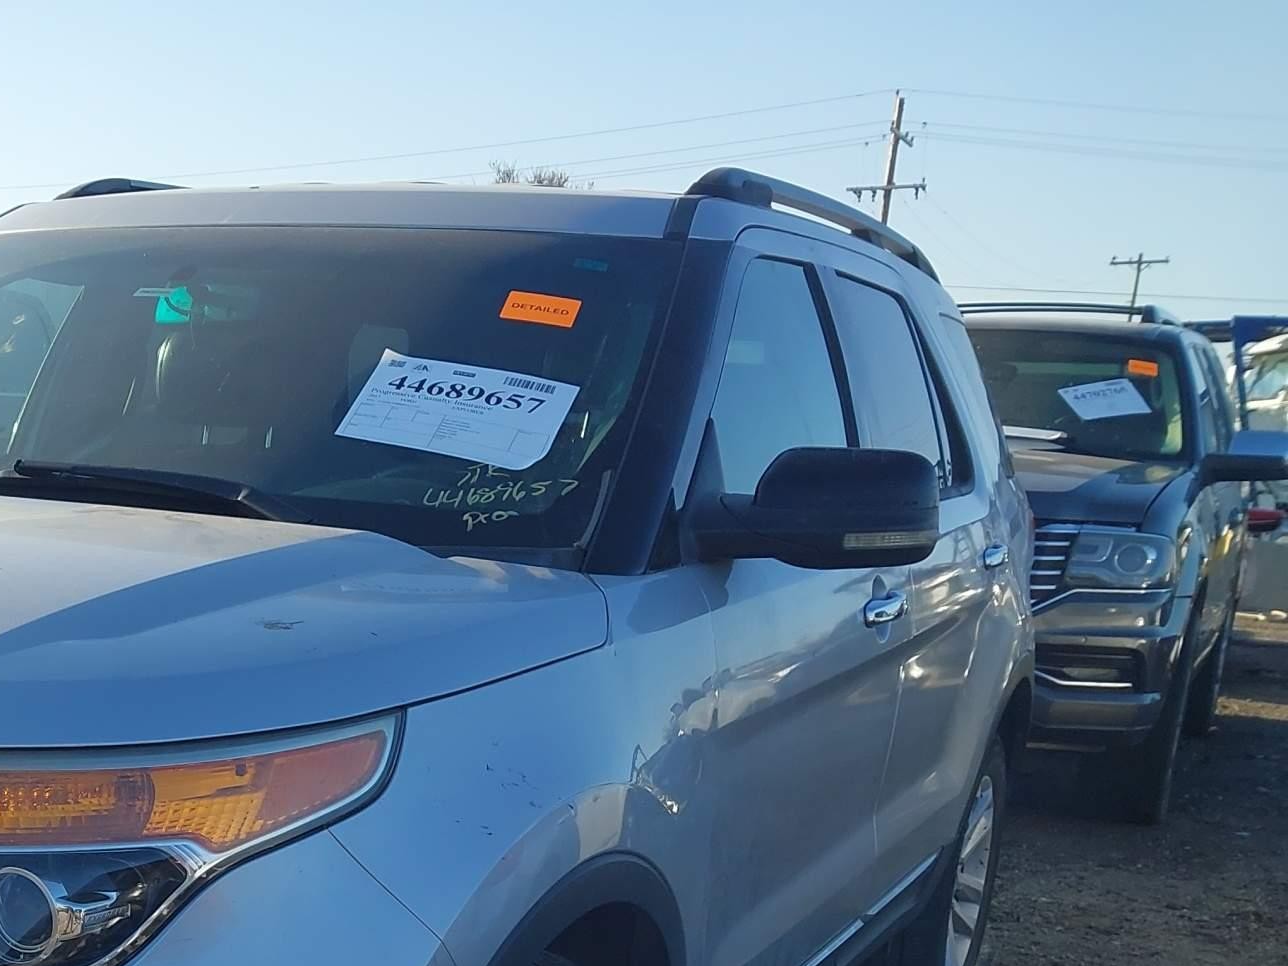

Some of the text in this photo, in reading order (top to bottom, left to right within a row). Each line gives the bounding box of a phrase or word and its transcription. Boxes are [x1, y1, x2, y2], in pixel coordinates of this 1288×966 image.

[511, 302, 569, 316] DETAILED
[371, 387, 416, 398] Progressive
[418, 394, 451, 404] Casualty
[454, 399, 494, 411] Insurance
[388, 375, 546, 414] 44689657
[423, 479, 579, 508] 44689657
